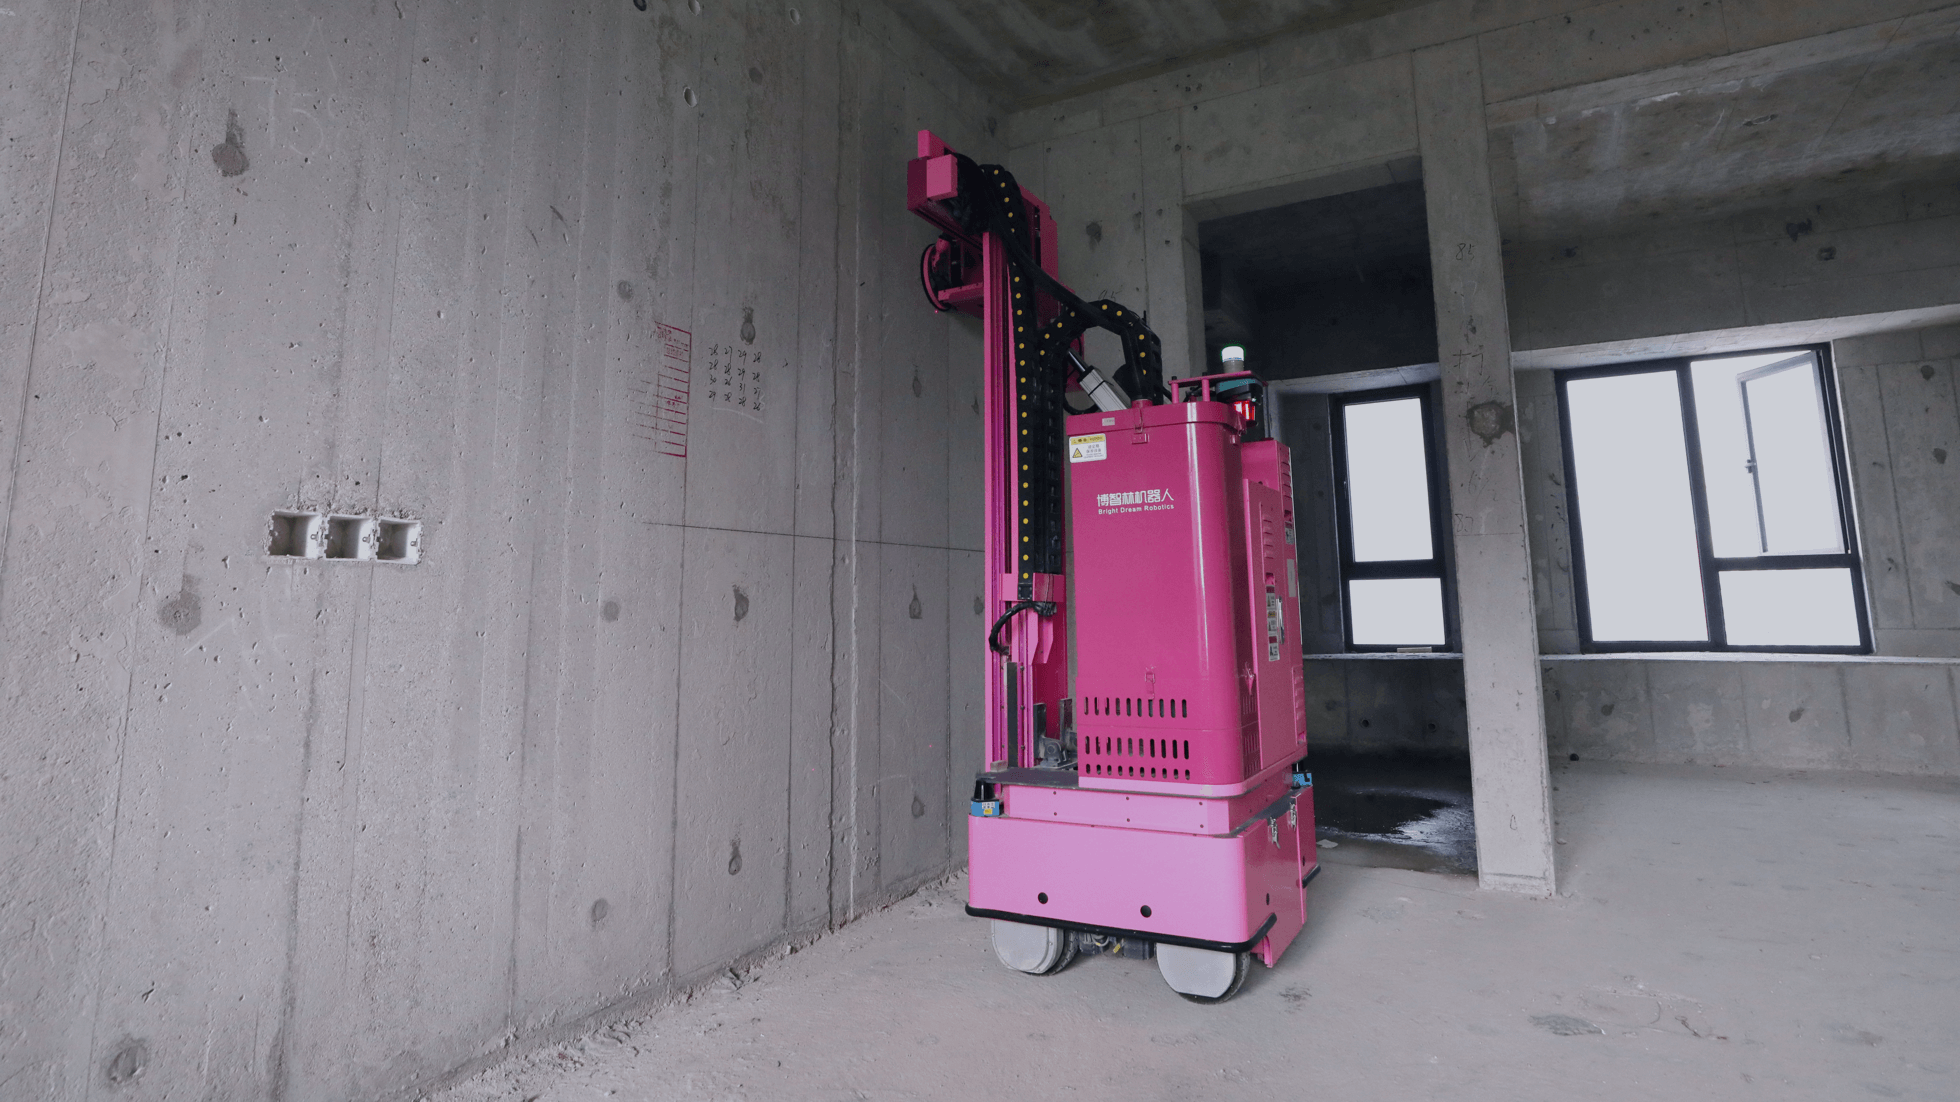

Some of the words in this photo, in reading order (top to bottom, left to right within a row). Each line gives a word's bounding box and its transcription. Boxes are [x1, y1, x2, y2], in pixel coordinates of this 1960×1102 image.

[1096, 488, 1175, 507] 博智林机器人
